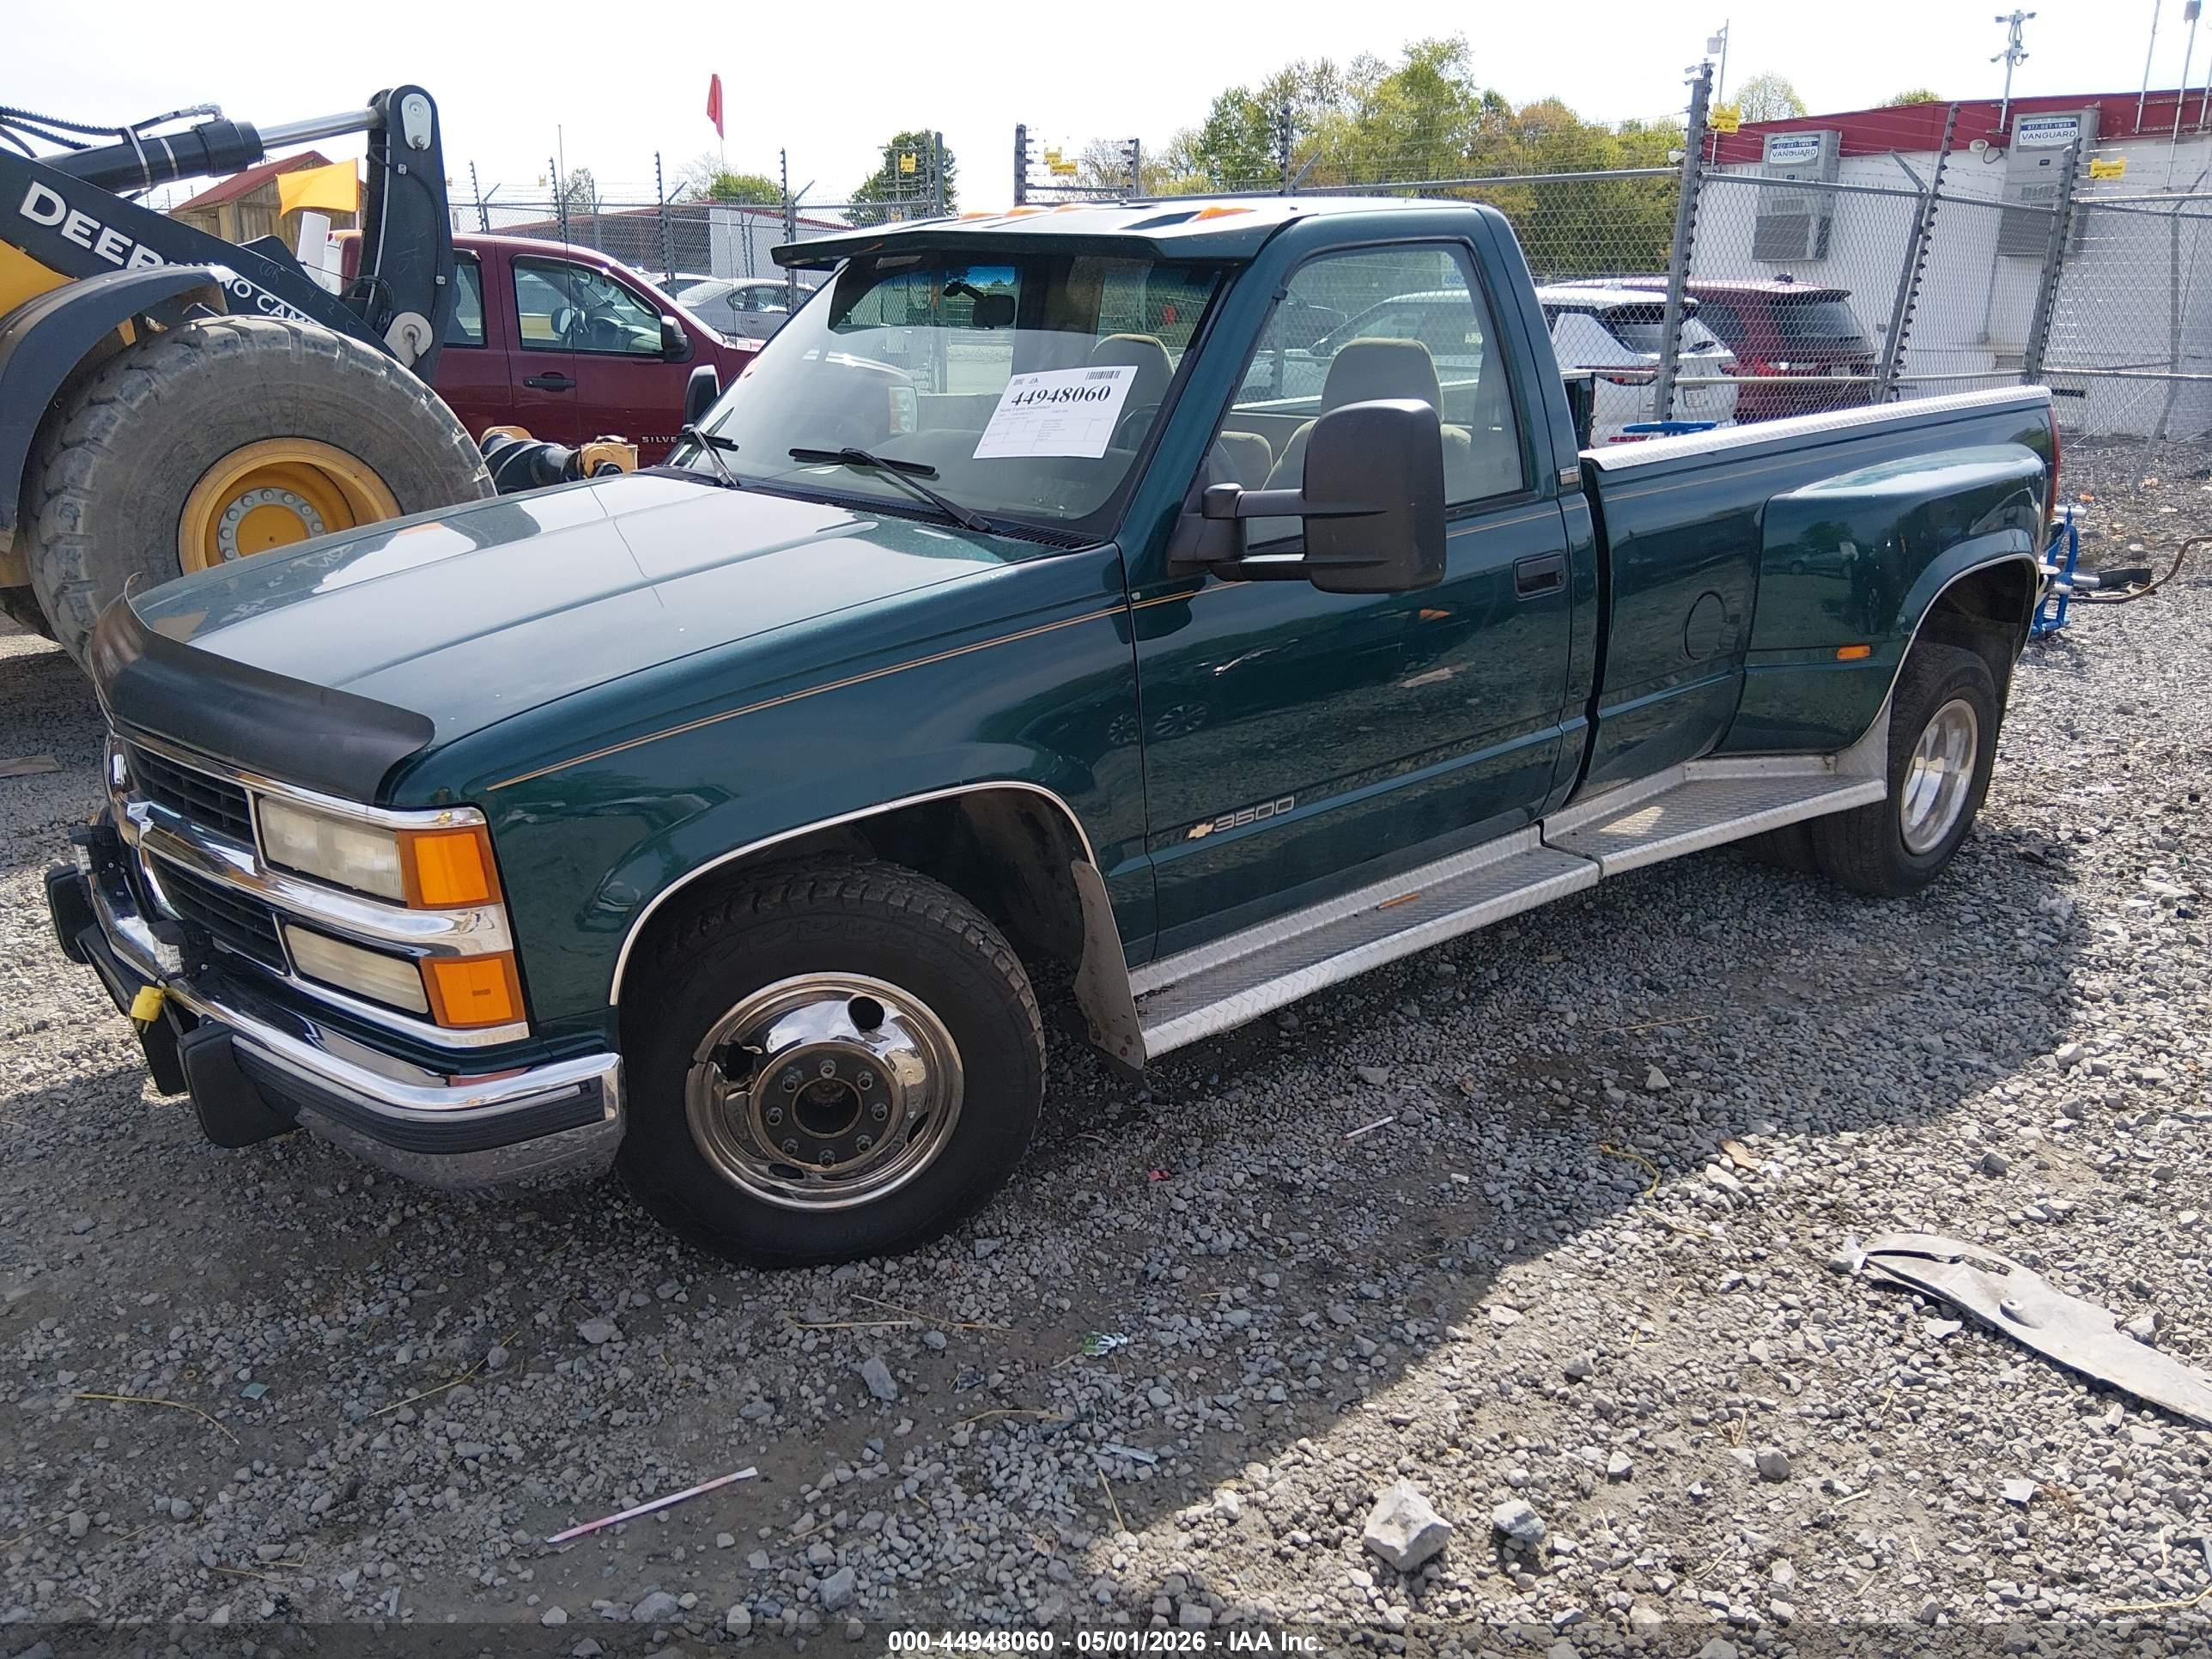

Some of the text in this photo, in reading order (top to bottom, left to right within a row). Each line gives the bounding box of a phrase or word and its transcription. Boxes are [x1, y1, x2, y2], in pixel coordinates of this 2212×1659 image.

[2022, 131, 2076, 140] VANGUARD
[1772, 149, 1816, 158] VANGUARD
[20, 181, 185, 269] DEER
[1012, 386, 1111, 405] 44948060
[1214, 796, 1294, 832] 3500
